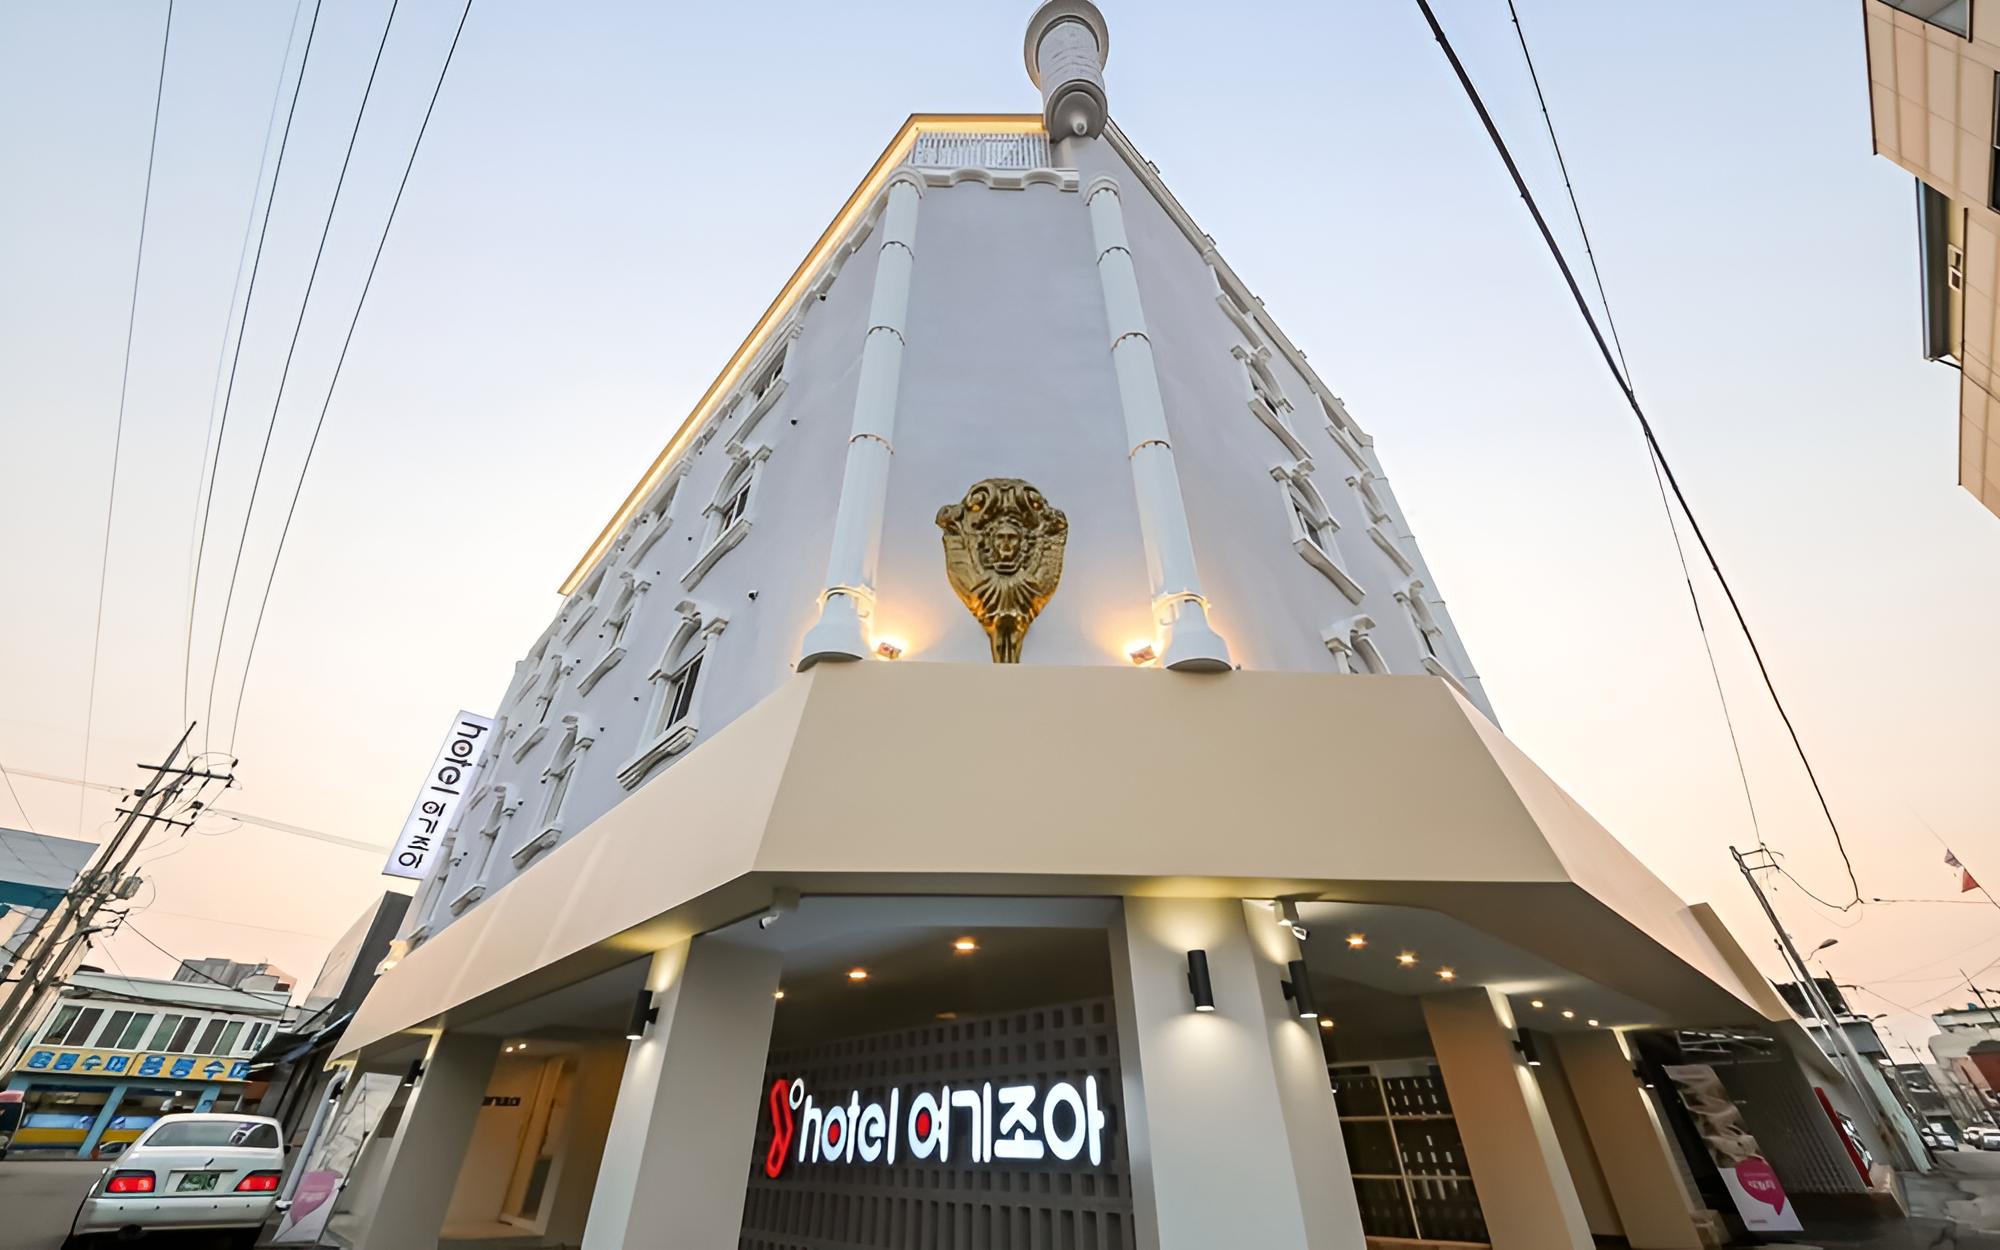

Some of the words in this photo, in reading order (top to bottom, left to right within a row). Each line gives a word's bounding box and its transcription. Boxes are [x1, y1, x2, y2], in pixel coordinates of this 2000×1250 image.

[431, 721, 488, 795] hotel
[799, 1087, 899, 1165] hotel
[908, 1075, 1105, 1166] 여기조아
